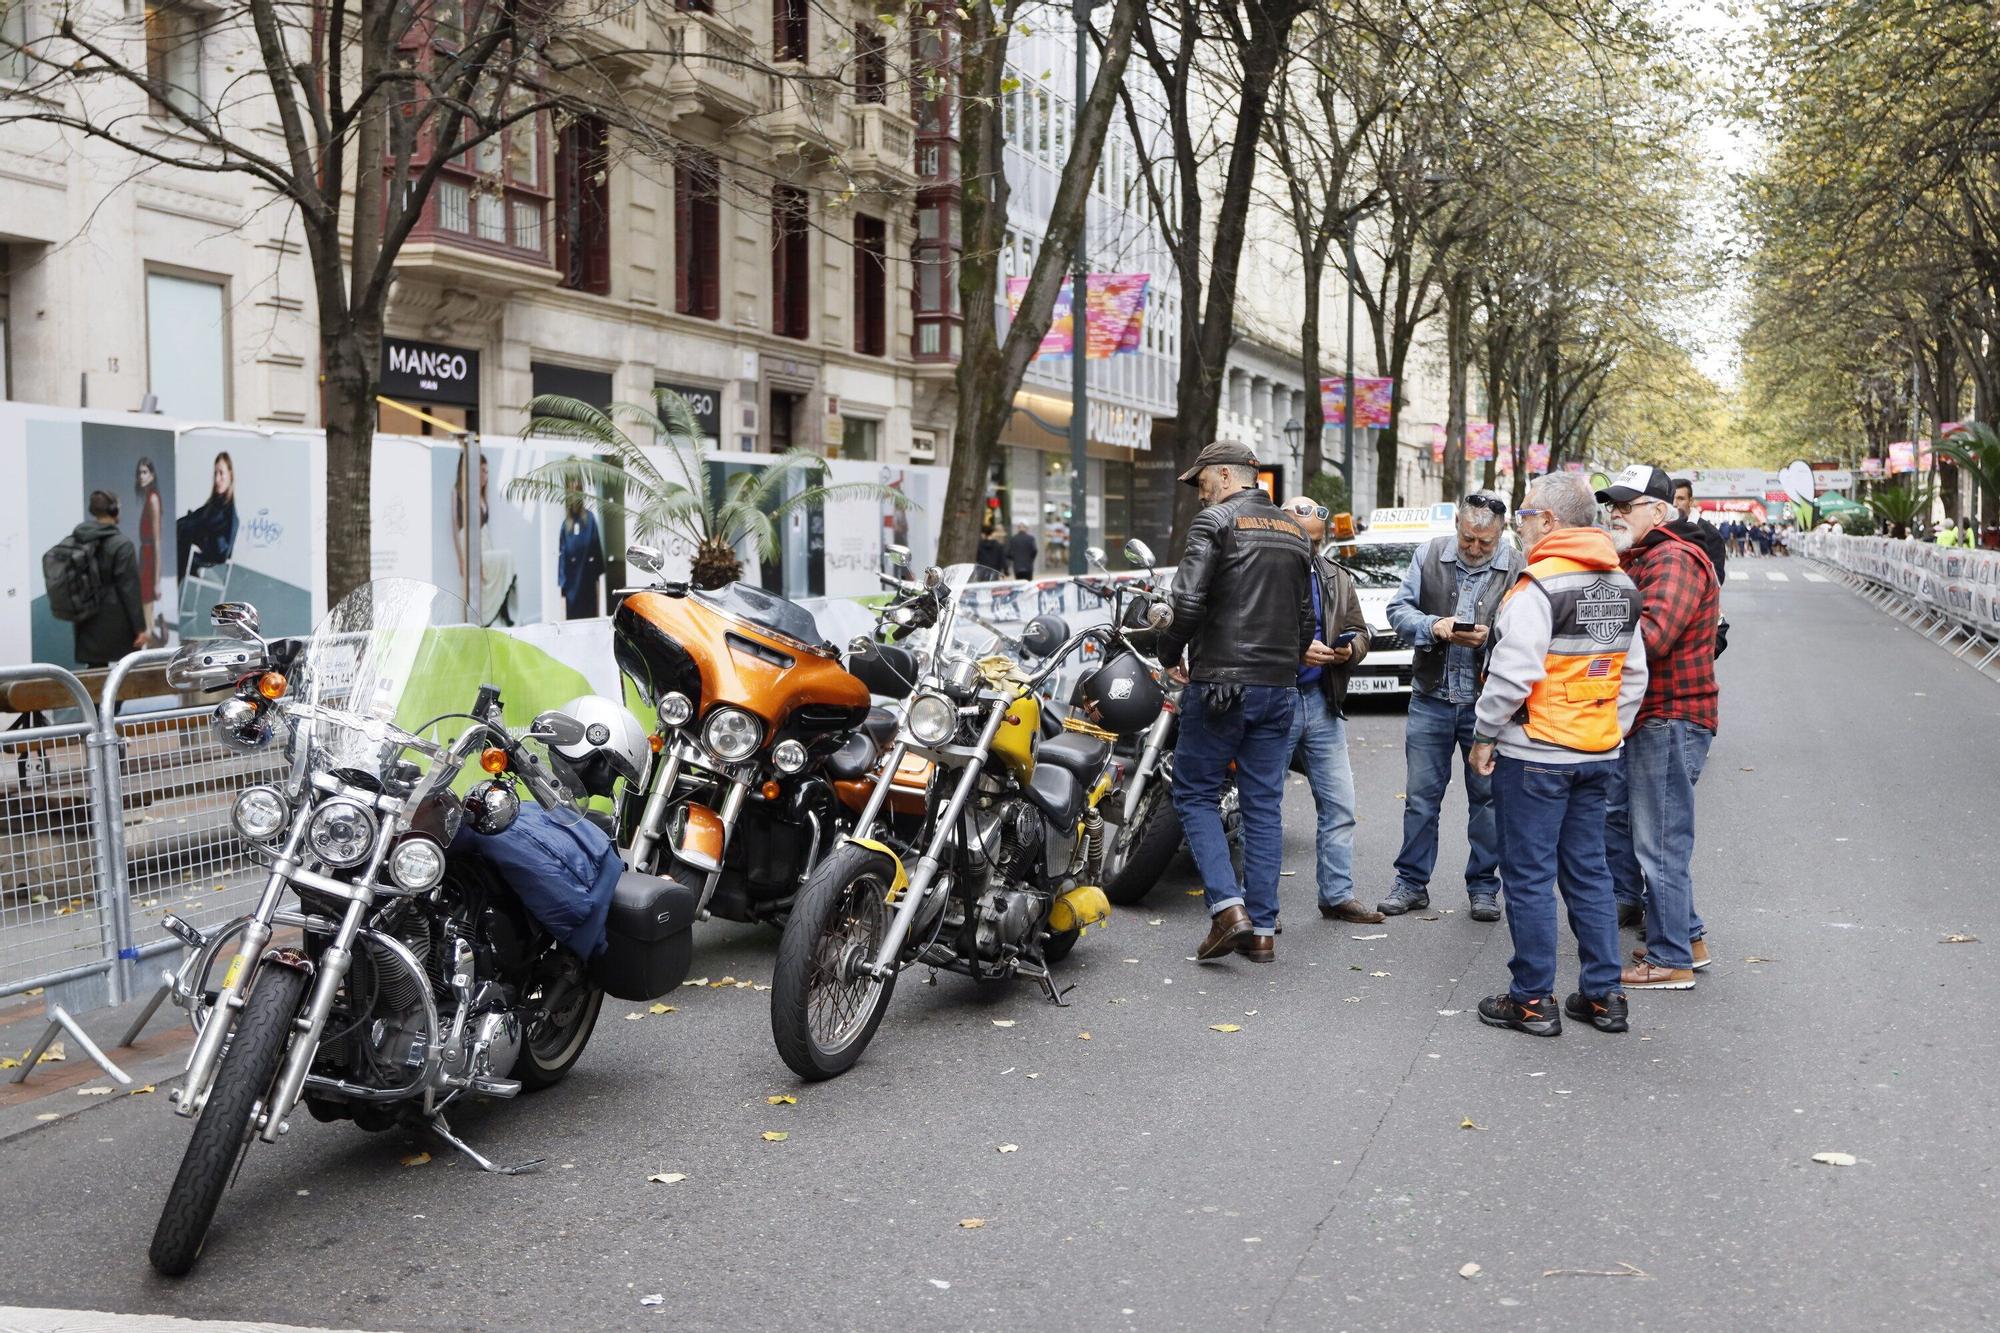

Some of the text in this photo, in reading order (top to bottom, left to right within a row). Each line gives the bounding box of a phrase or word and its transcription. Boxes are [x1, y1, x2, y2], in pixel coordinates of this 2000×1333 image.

[389, 345, 467, 380] MANGO
[1373, 506, 1448, 522] BASURTO L
[1591, 586, 1616, 600] MOTOR
[1580, 604, 1627, 618] HARLEY-DAVIDSON
[1590, 622, 1618, 638] CYCLES
[1373, 679, 1394, 690] MMY
